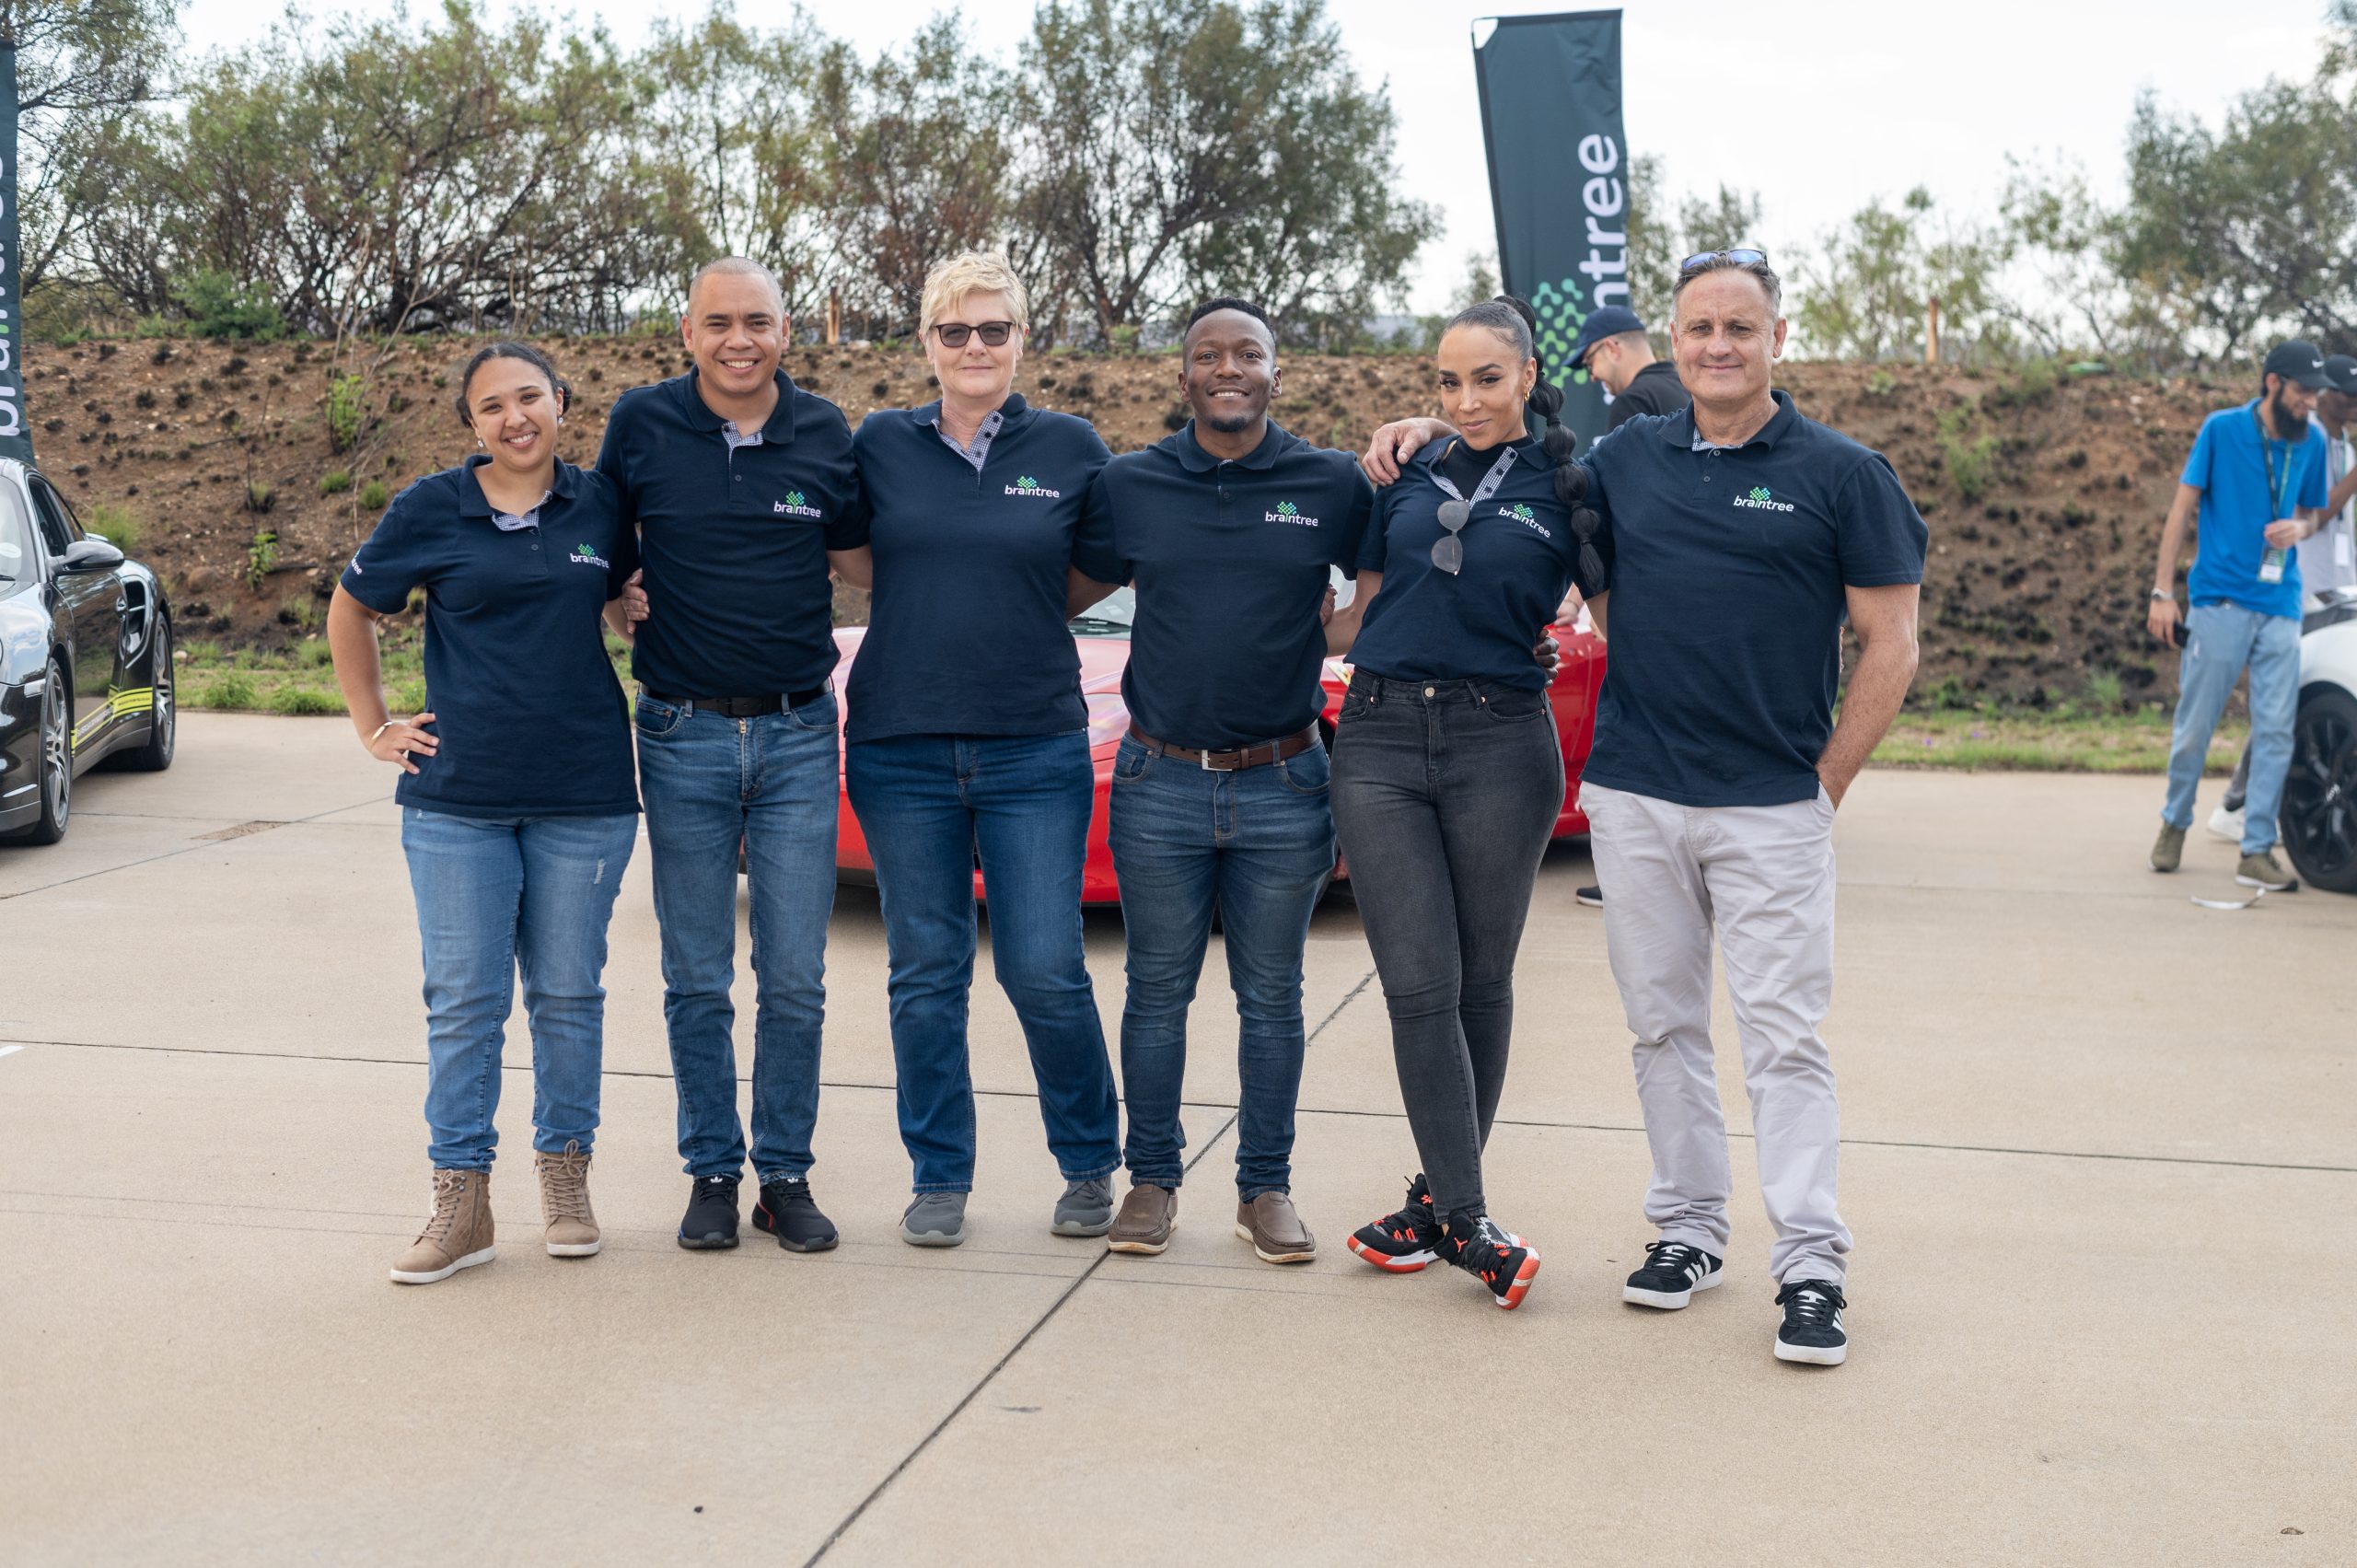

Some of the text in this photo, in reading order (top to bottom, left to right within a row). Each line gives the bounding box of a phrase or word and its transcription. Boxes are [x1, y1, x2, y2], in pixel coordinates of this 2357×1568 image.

[1004, 484, 1060, 498] braintree
[773, 500, 821, 517] braintree
[1733, 495, 1794, 512] braintree
[1265, 510, 1318, 527] braintree
[1498, 506, 1550, 539] braintree
[569, 552, 610, 569] braintree
